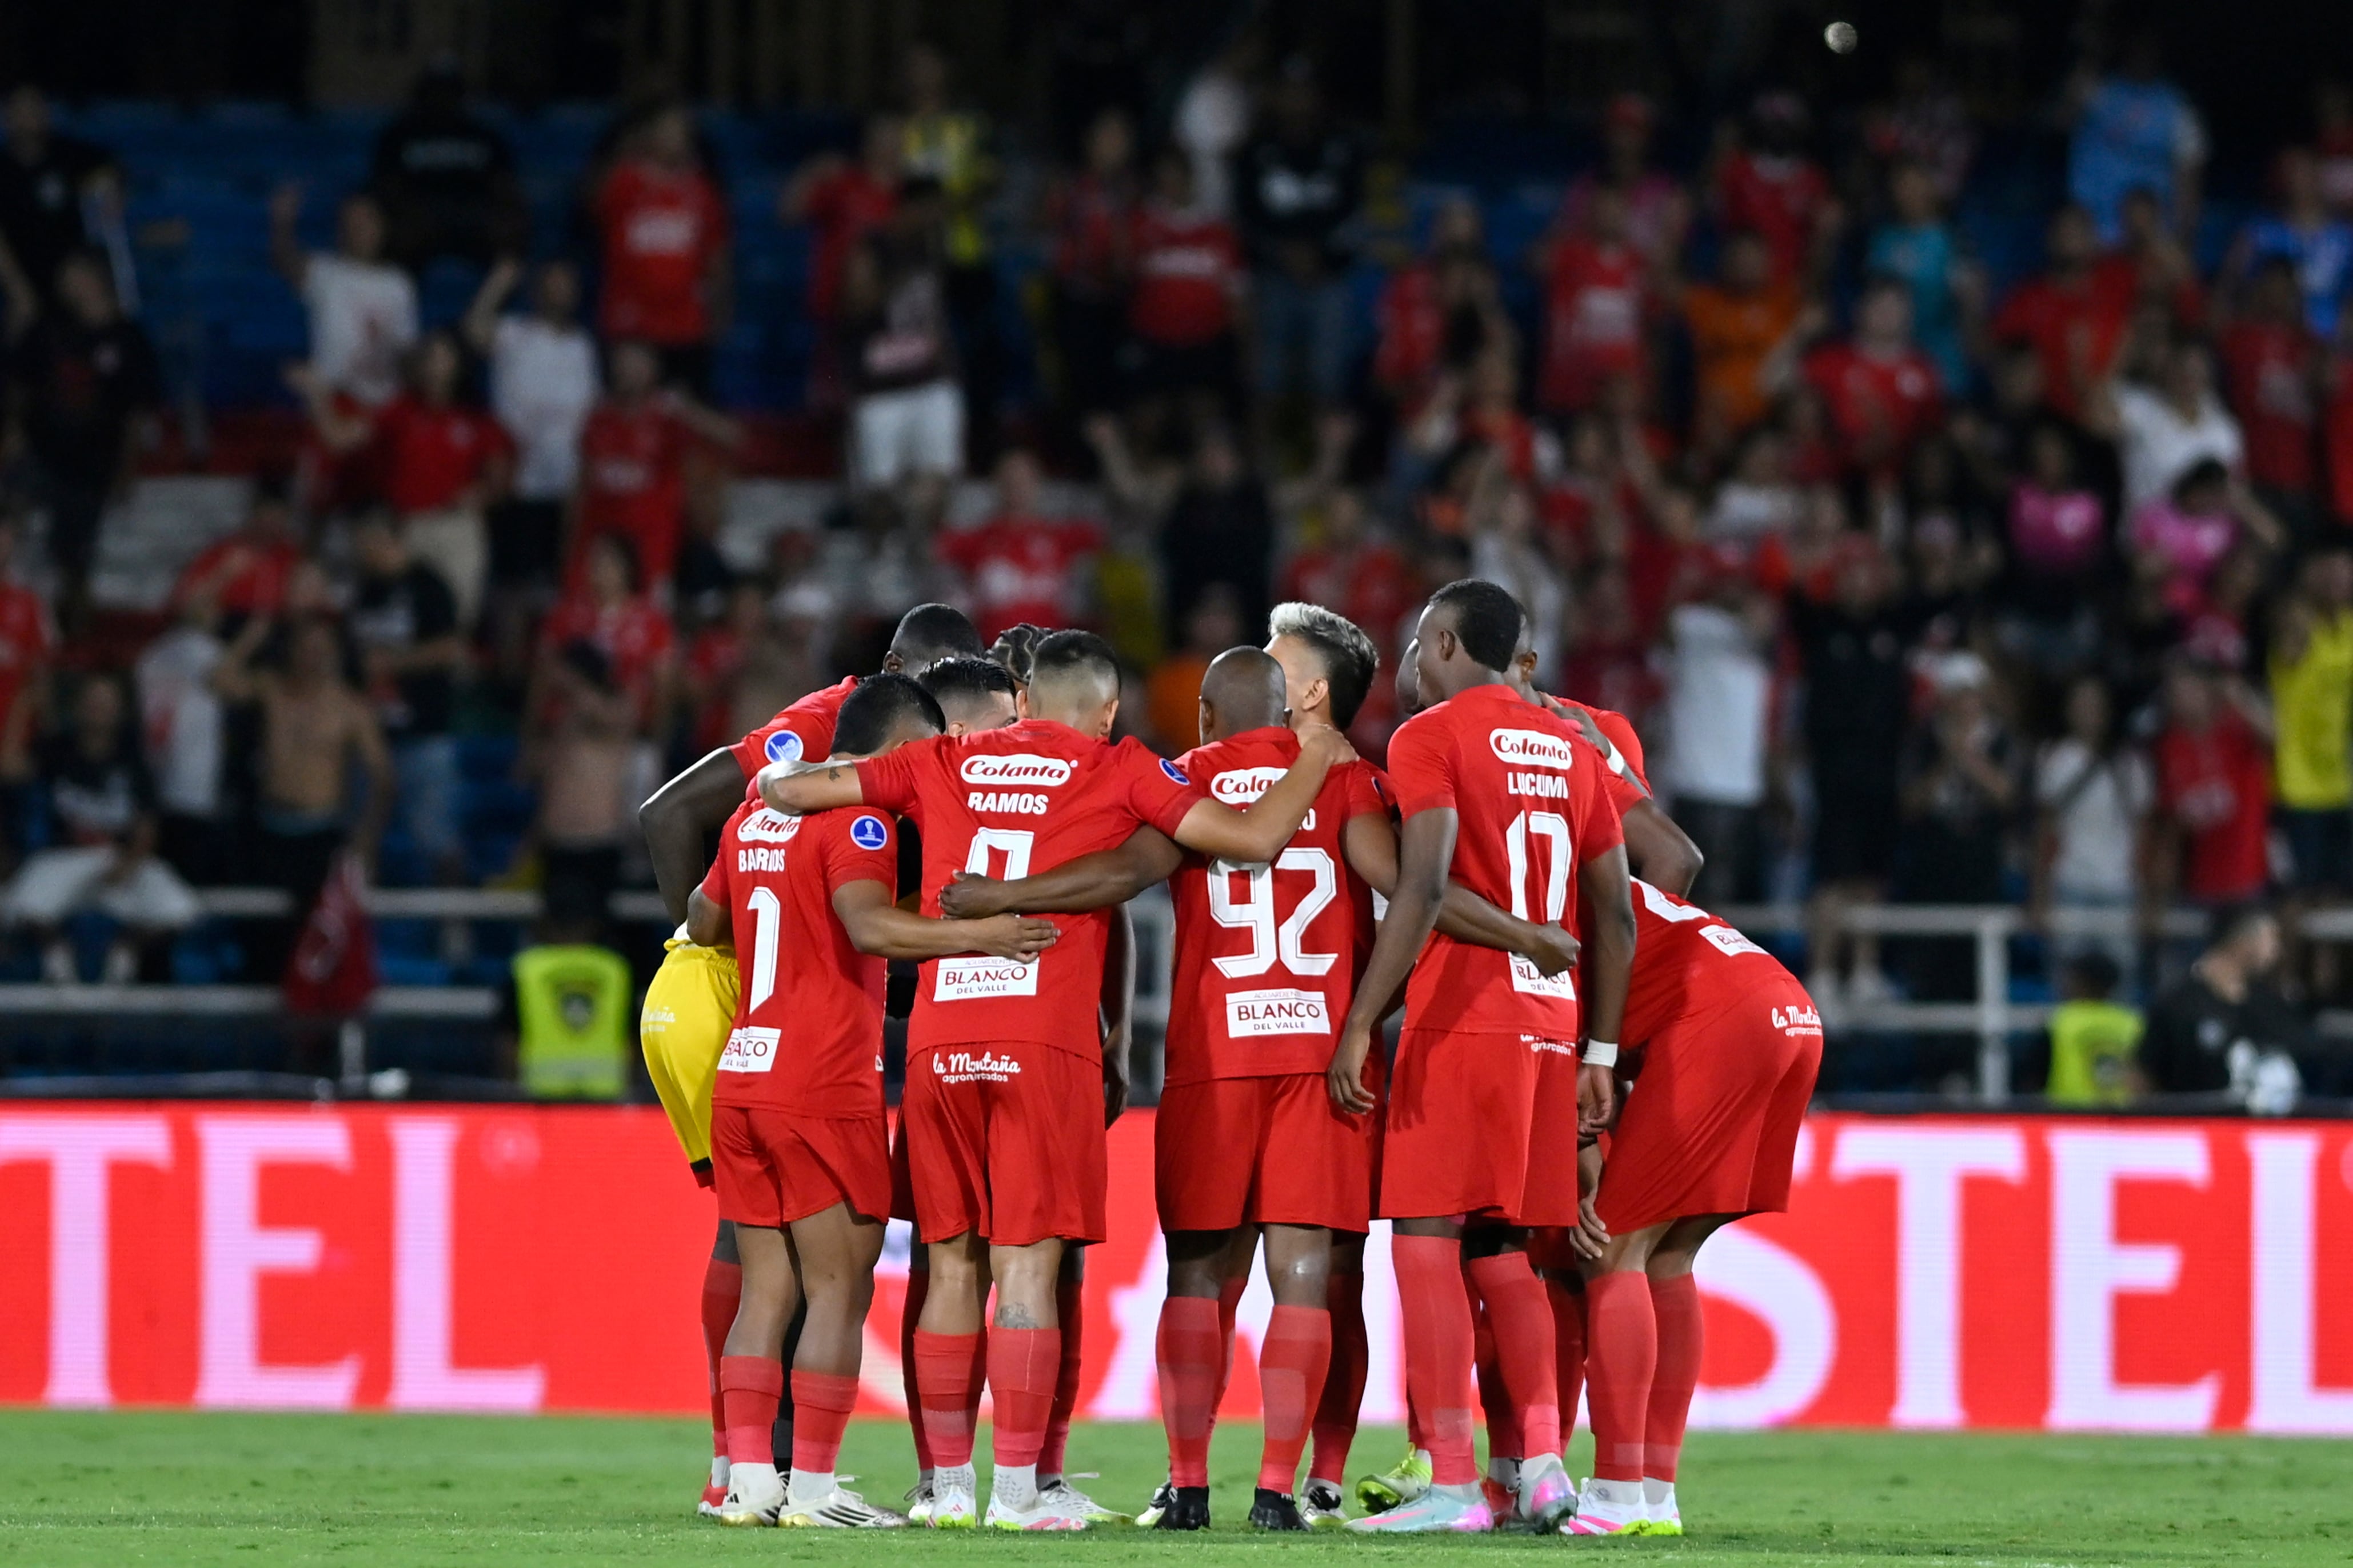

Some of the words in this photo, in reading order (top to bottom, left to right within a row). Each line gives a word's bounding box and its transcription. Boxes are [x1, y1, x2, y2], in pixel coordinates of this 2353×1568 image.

[1494, 734, 1568, 761] Colanta
[965, 760, 1066, 779] Colanta
[1215, 775, 1276, 795] Cola
[1507, 771, 1569, 799] LUCUMI
[967, 791, 1049, 815] RAMOS
[741, 815, 798, 833] Clanta
[1207, 847, 1339, 979] 92
[746, 886, 780, 1014] 1
[945, 966, 1028, 986] BLANCO
[1237, 1002, 1320, 1021] BLANCO
[1275, 1021, 1306, 1029] VALLE
[933, 1052, 946, 1074] la
[948, 1051, 1021, 1074] Montaña
[0, 1112, 548, 1410] TEL
